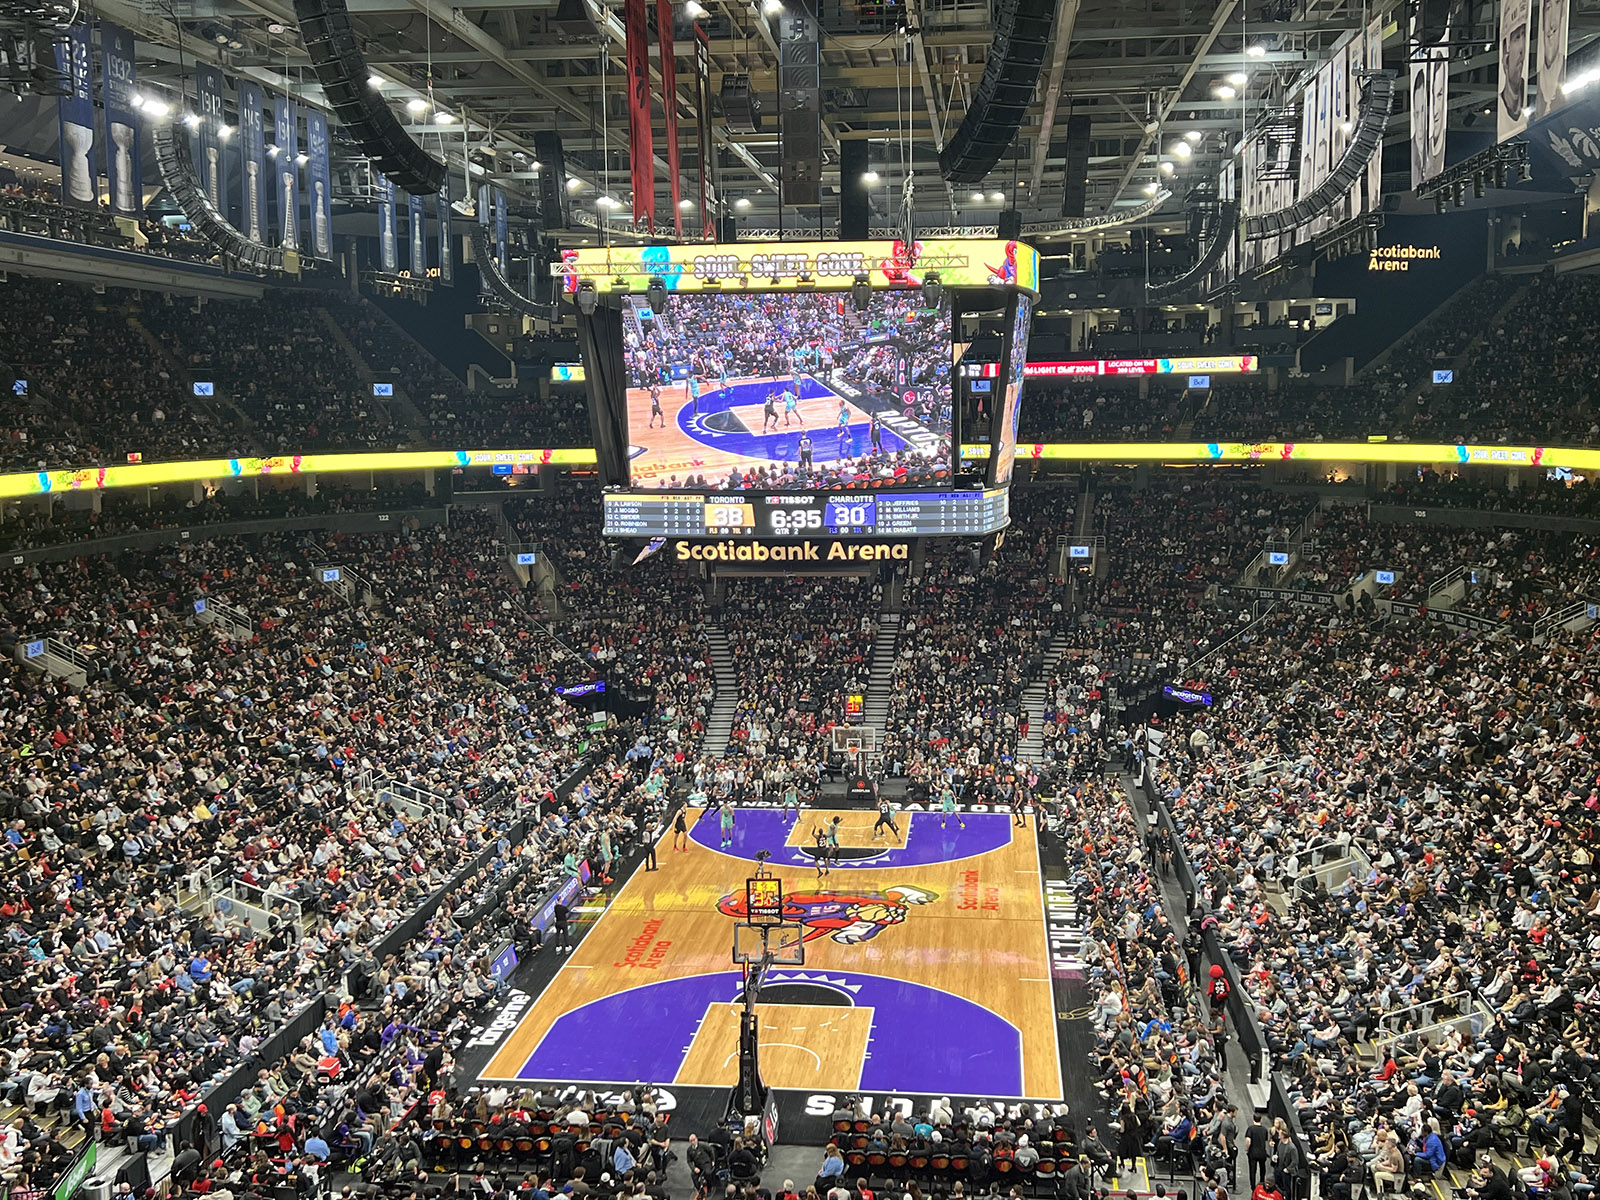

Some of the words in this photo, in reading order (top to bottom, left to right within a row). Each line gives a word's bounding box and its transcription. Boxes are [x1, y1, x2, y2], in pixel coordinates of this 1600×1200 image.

[1370, 244, 1441, 259] Scotiabank
[1368, 258, 1409, 271] Arena
[1034, 366, 1055, 374] LIGHT
[1076, 365, 1096, 373] ZONE
[709, 496, 745, 504] TORONTO
[780, 496, 816, 504] TISSOT
[828, 495, 874, 503] CHARLOTTE
[714, 506, 743, 526] 38
[771, 509, 822, 529] 6:35
[834, 506, 866, 526] 30
[675, 540, 819, 561] Scotiabank
[827, 540, 908, 561] Arena
[957, 870, 978, 910] Scotiabank
[980, 887, 999, 911] Arena
[1045, 879, 1077, 920] NORTH
[613, 919, 664, 968] Scotiabank
[1048, 923, 1084, 949] THE
[639, 941, 672, 969] Arena
[1054, 953, 1090, 970] WE
[466, 993, 531, 1048] Tangerine
